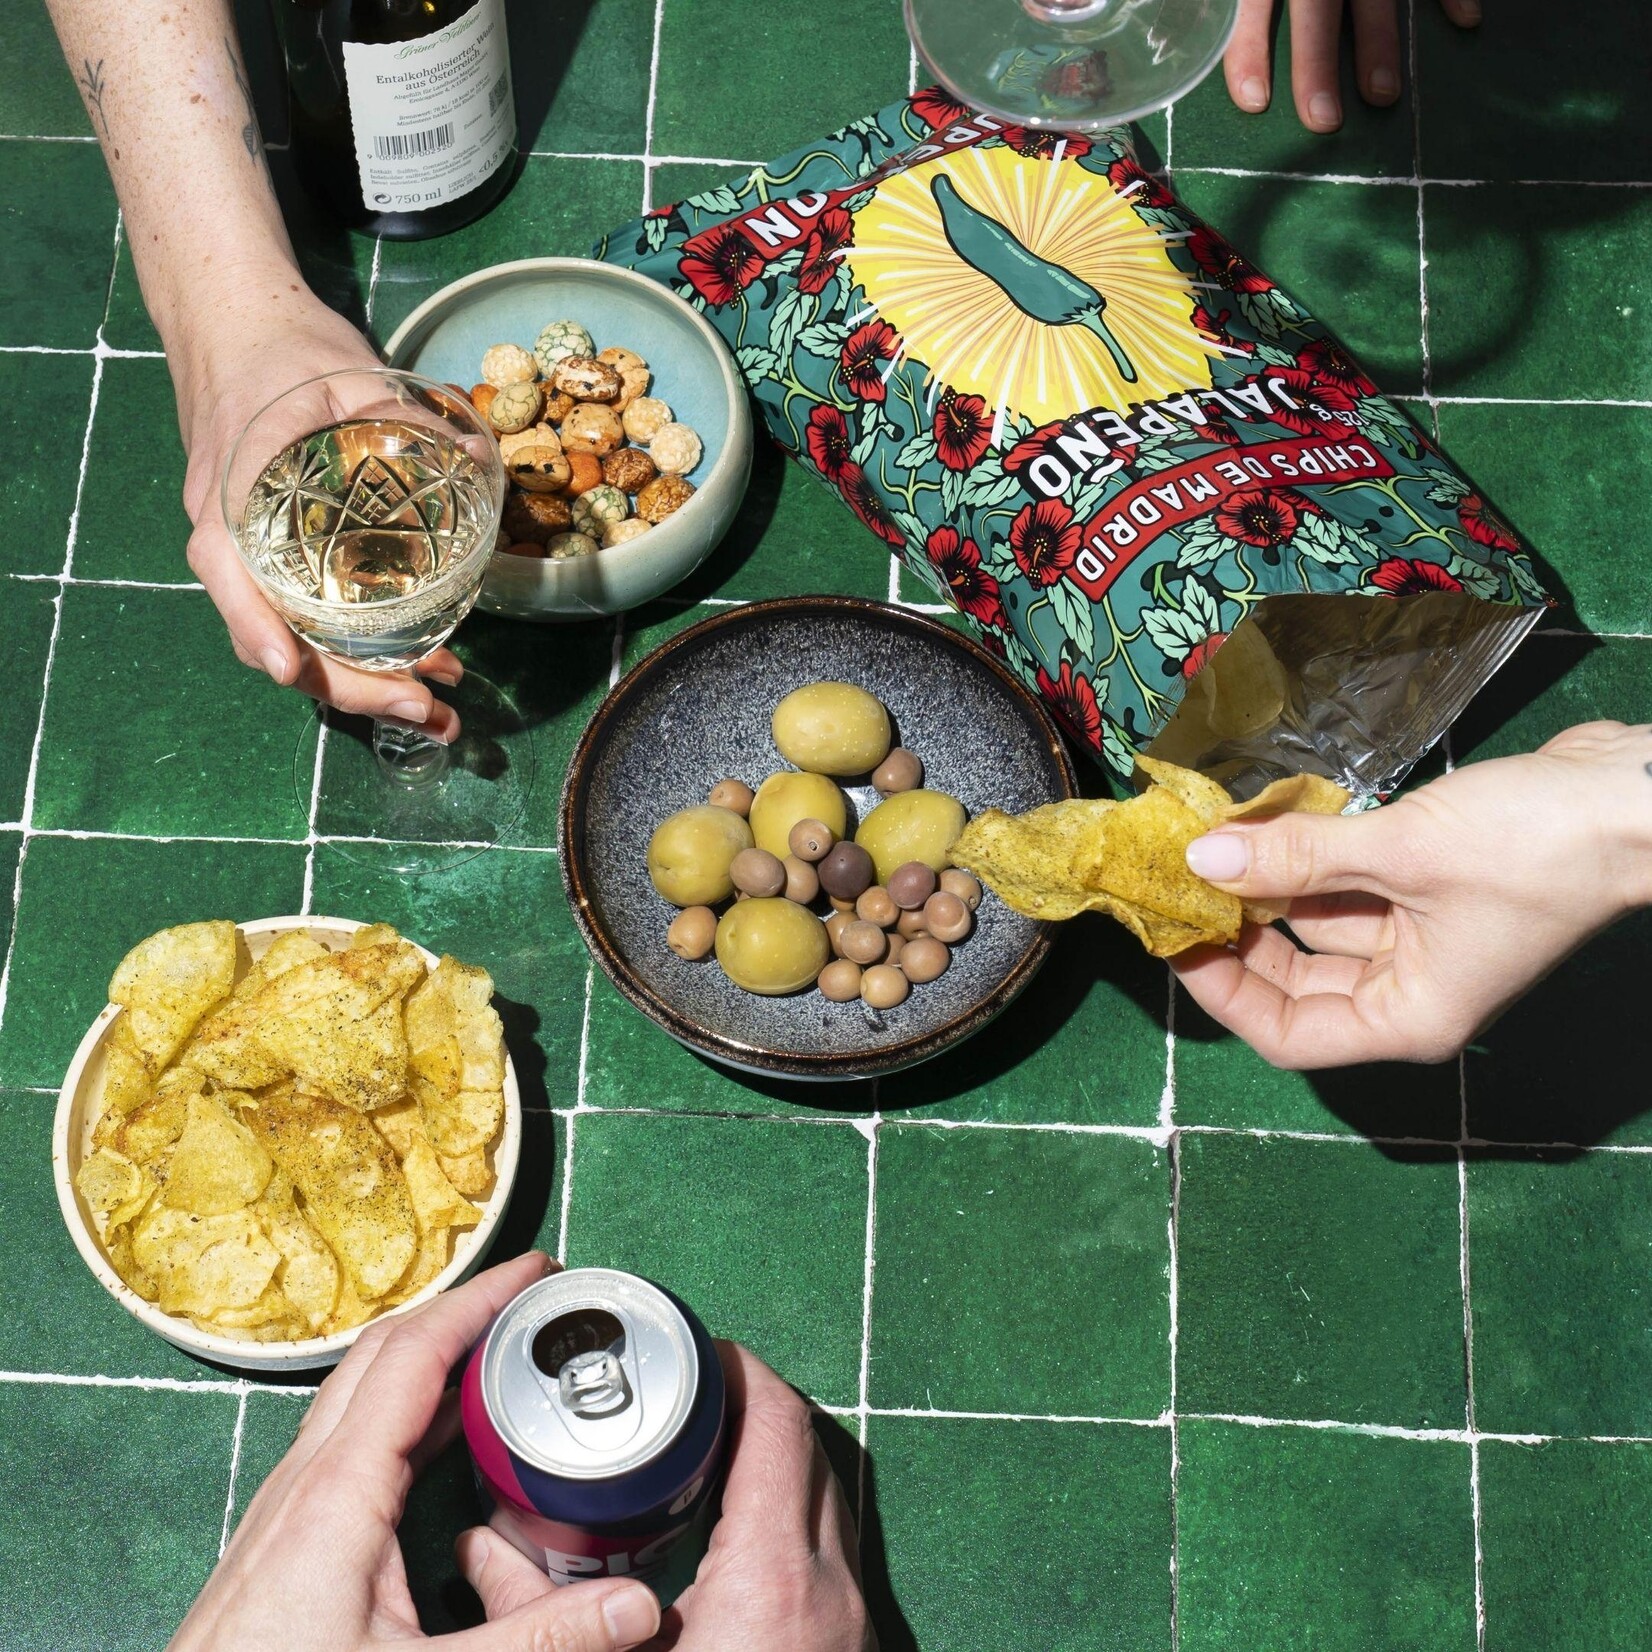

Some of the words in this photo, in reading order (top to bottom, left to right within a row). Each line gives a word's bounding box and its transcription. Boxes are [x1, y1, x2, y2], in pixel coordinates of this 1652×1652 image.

[376, 43, 475, 84] Entalkoholisierter
[405, 79, 426, 91] aus
[429, 49, 481, 84] Österreich
[395, 193, 421, 204] 750
[425, 187, 442, 201] ml
[1308, 403, 1332, 422] g
[1331, 410, 1370, 427] 125
[1029, 377, 1304, 497] JALAPEÑO
[1214, 456, 1273, 487] DE
[1270, 444, 1377, 478] CHIPS
[1075, 473, 1220, 582] MADRID
